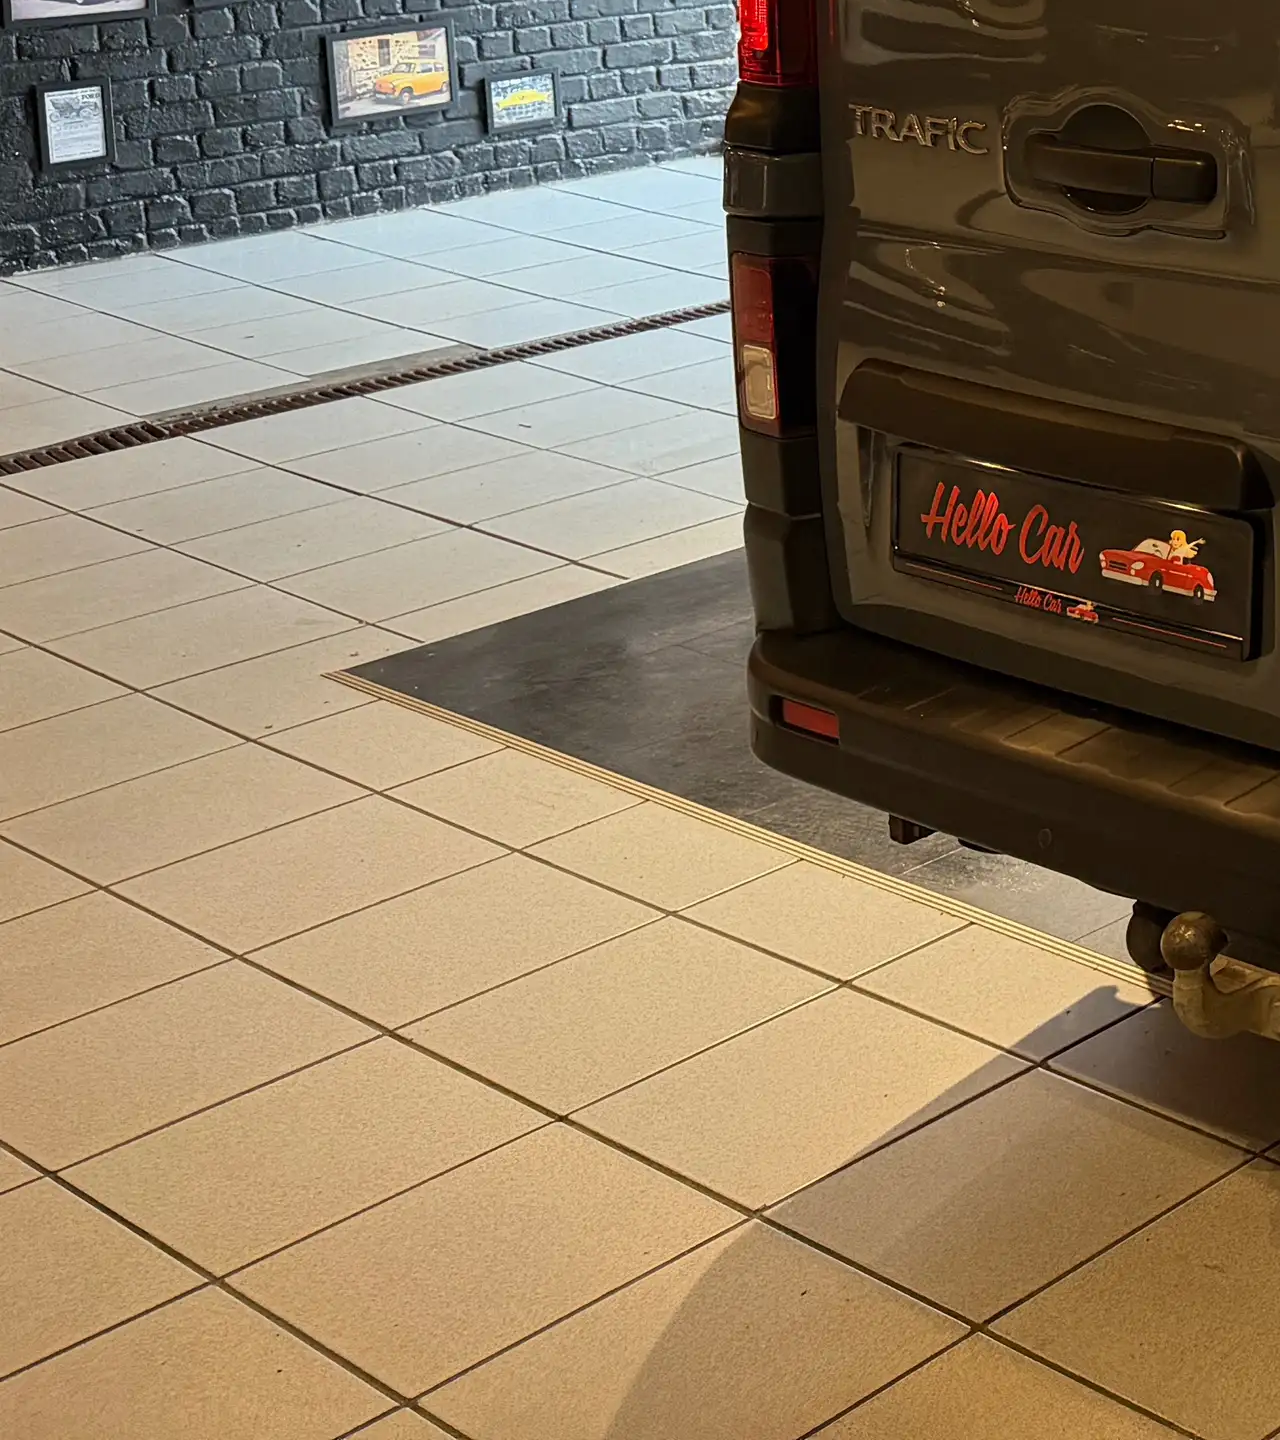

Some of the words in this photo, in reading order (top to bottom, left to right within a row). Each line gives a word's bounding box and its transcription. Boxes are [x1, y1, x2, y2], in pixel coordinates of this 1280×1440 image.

[848, 103, 989, 156] TRAFIC
[920, 480, 1014, 557] Hello
[1018, 503, 1085, 575] Car
